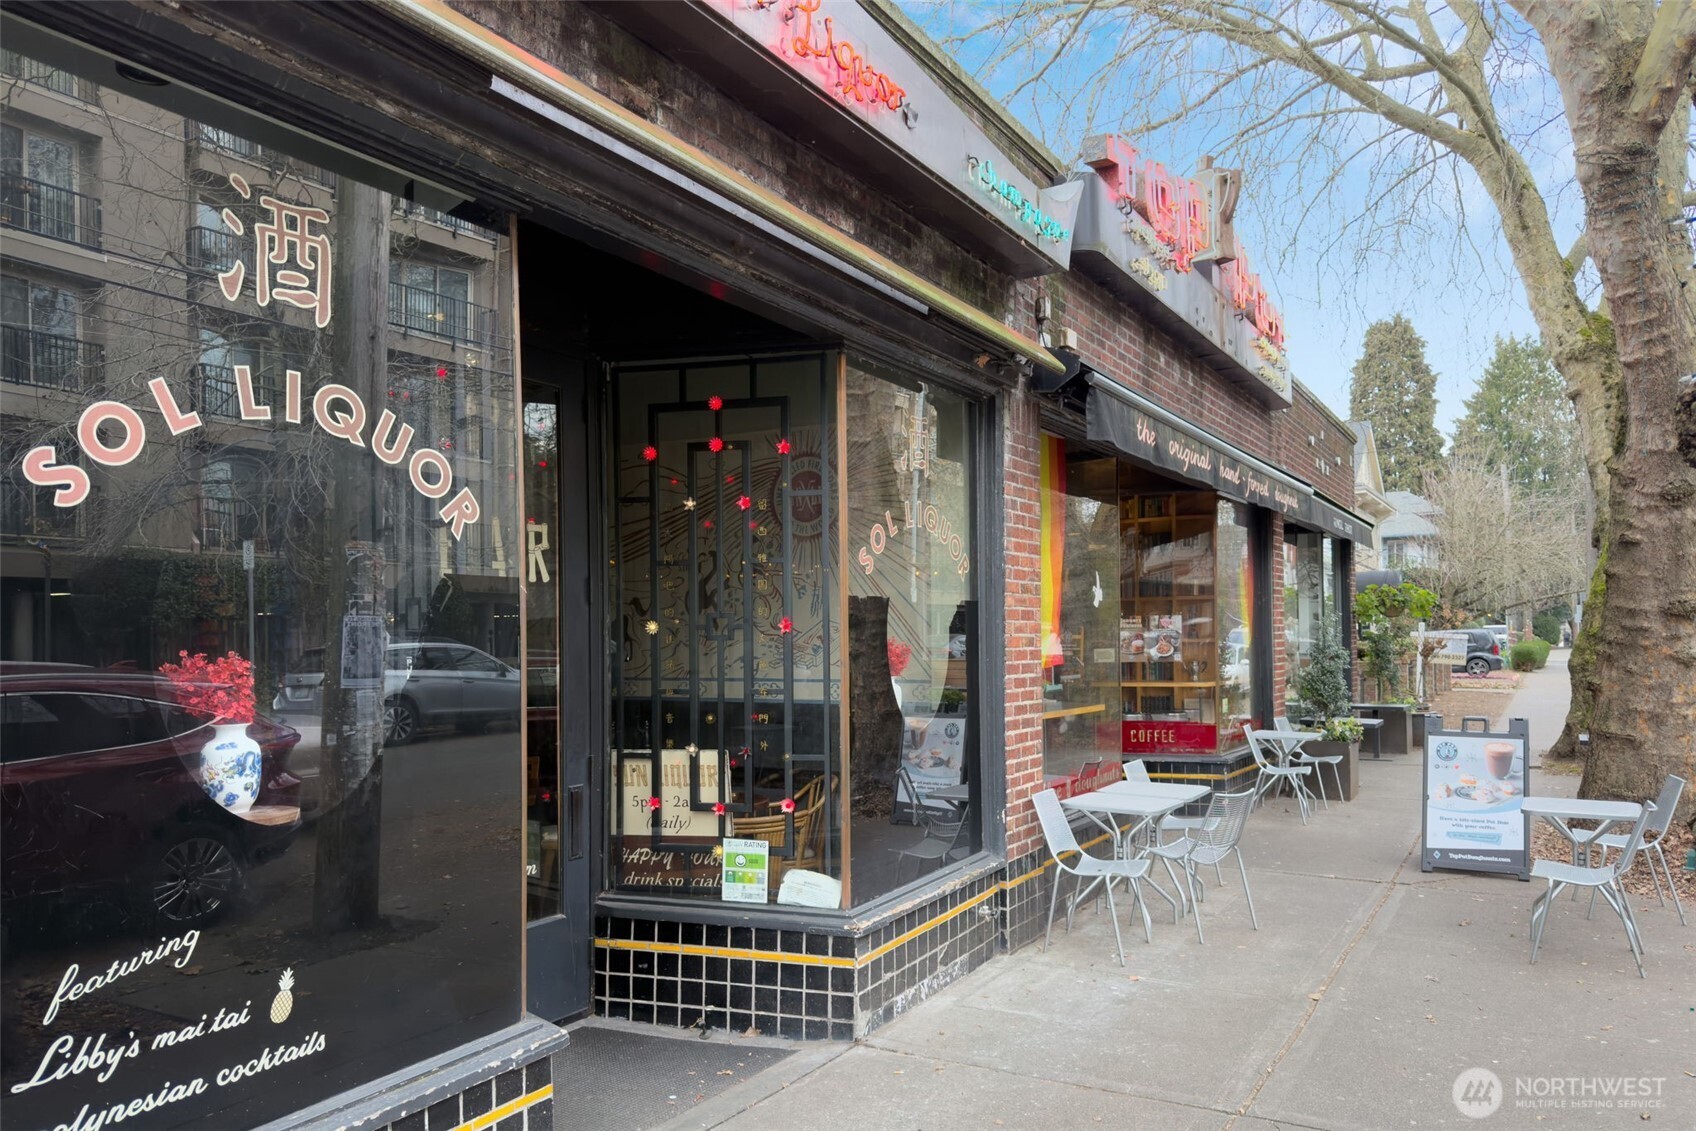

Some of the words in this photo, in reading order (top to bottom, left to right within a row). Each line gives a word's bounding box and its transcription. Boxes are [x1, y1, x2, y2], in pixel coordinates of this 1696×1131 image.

[217, 173, 331, 329] 酒
[21, 376, 202, 507] SOL
[234, 365, 481, 541] LIQUOR
[1136, 416, 1156, 447] the
[1168, 439, 1211, 471] original
[858, 509, 898, 575] SOL
[904, 500, 970, 583] LIQUOR
[1130, 729, 1176, 743] COFFEE
[646, 815, 691, 834] (aily)
[743, 840, 767, 849] RATING
[624, 871, 662, 886] drink
[42, 928, 200, 1025] featuring
[10, 1031, 140, 1093] Libby's
[151, 1013, 205, 1050] mai
[208, 1000, 252, 1034] tai
[216, 1031, 327, 1086] cocktails
